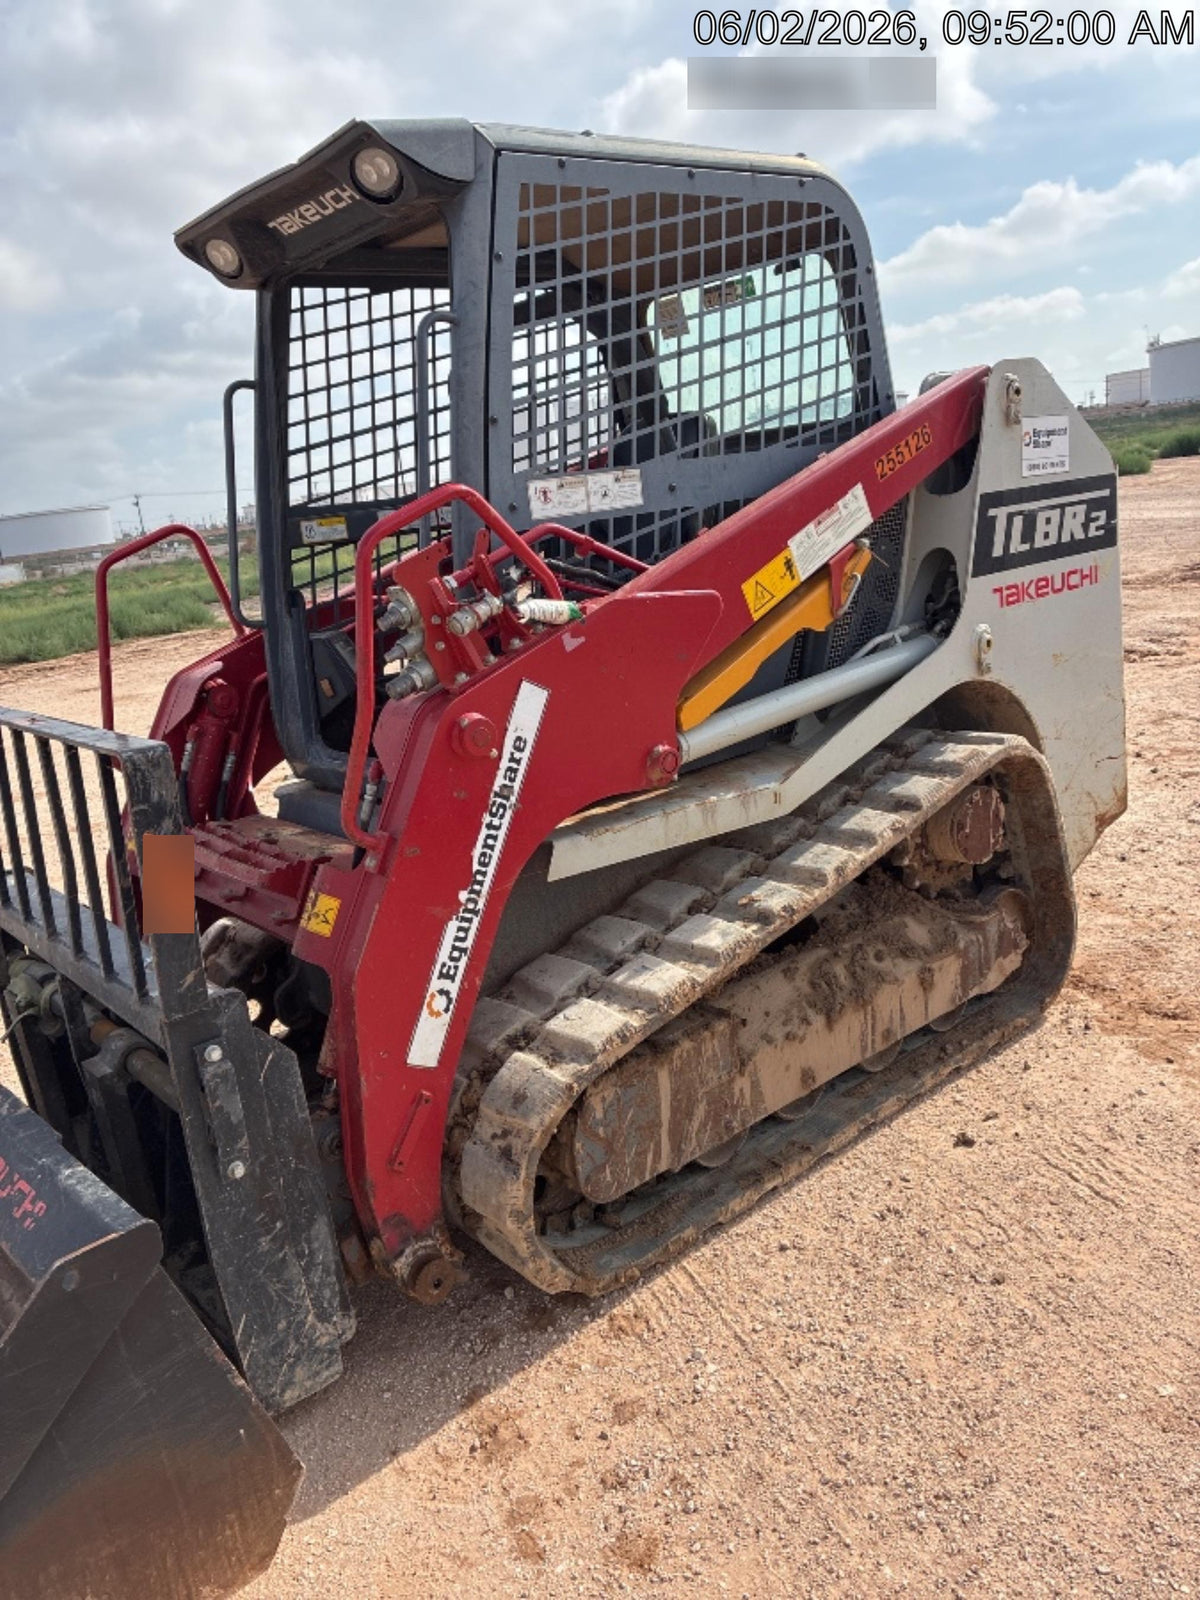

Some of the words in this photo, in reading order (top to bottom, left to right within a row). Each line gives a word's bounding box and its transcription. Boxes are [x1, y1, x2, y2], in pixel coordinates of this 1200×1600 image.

[266, 183, 361, 236] TAKEUCH
[875, 424, 932, 480] 255126
[437, 734, 528, 985] EquipmentShare
